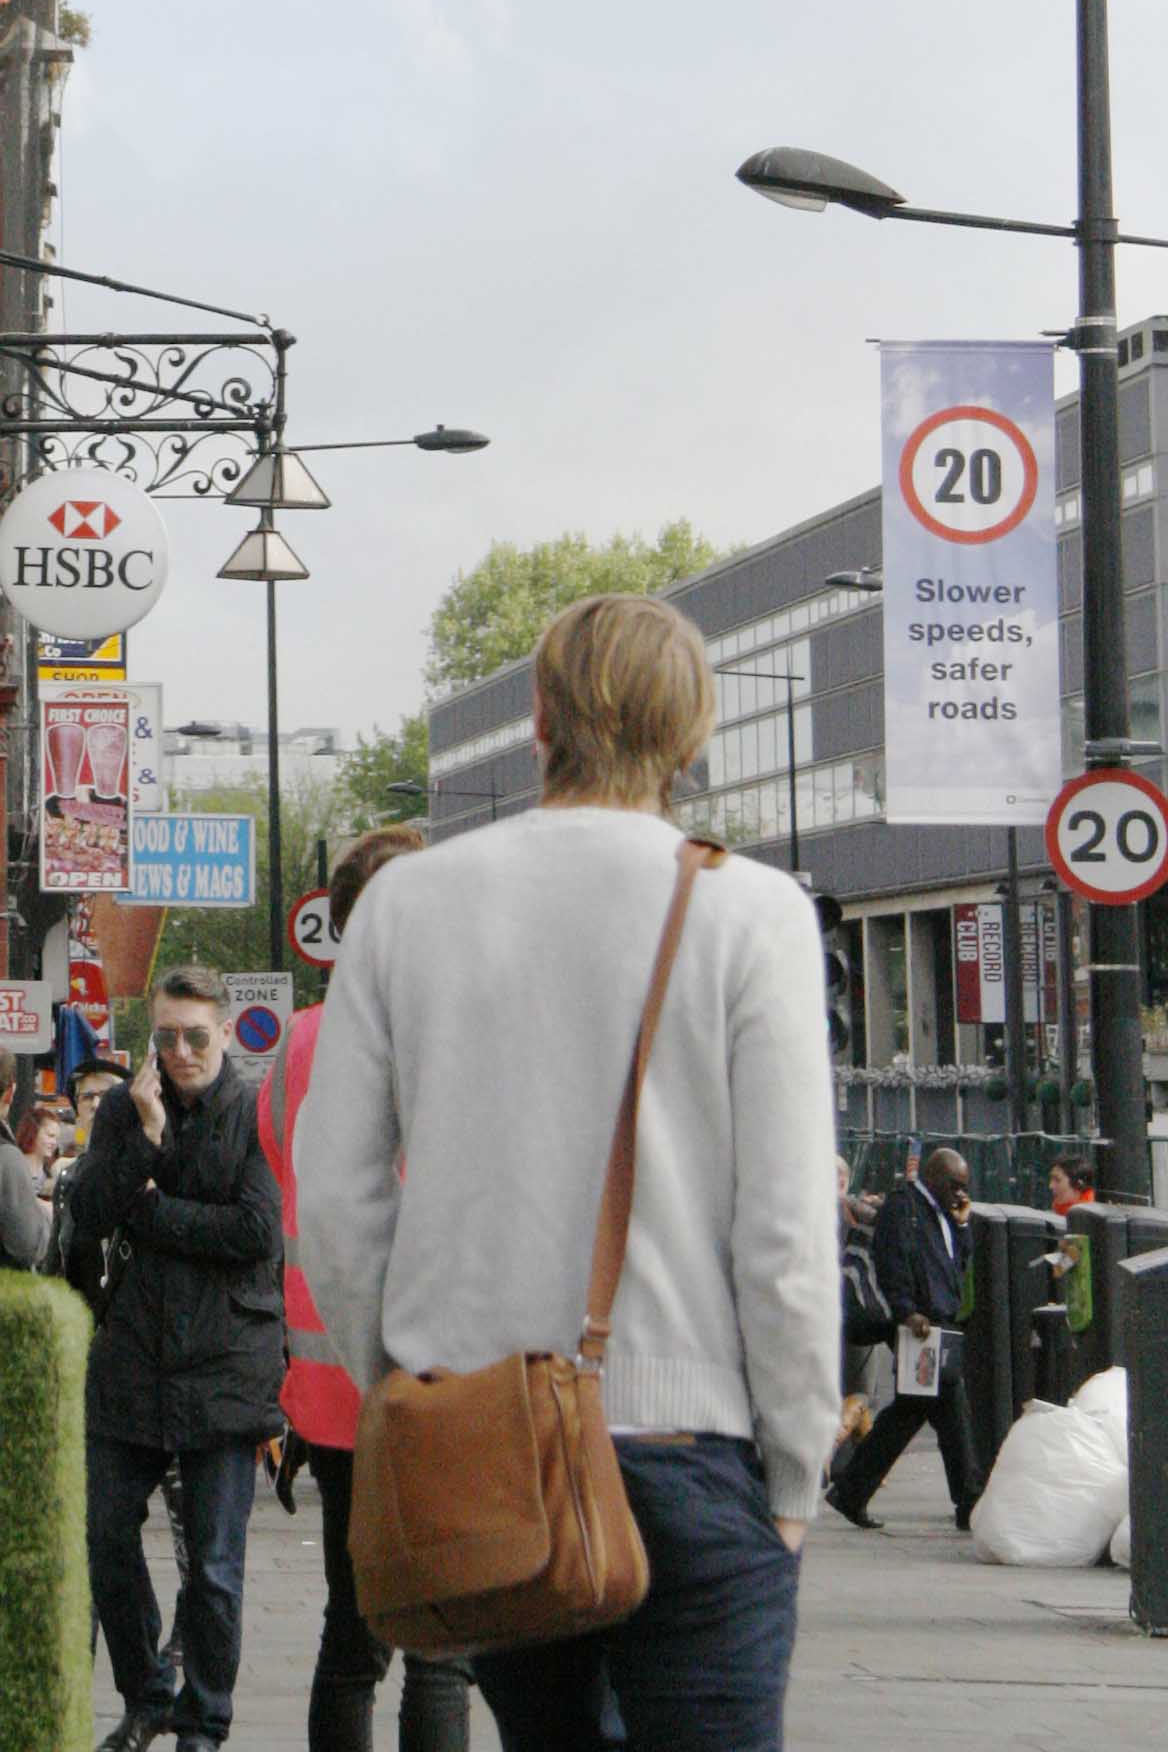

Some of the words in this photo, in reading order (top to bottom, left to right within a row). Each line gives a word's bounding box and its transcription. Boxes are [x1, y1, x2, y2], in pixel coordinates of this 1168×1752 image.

[934, 448, 1002, 504] 20
[13, 546, 153, 590] HSBC
[915, 578, 1026, 603] Slower
[908, 619, 1033, 647] speeds,
[931, 658, 1013, 681] safer
[48, 709, 81, 722] FIRST
[84, 709, 127, 723] CHOICE
[928, 697, 1018, 720] roads
[133, 820, 169, 853] OOD
[173, 820, 189, 853] &
[192, 820, 240, 854] WINE
[1067, 810, 1159, 863] 20
[48, 871, 122, 886] OPEN
[176, 864, 191, 897] &
[195, 864, 245, 898] MAGS
[957, 920, 978, 961] CLUB
[983, 921, 1002, 982] RECORD
[226, 975, 288, 986] Controlled
[235, 989, 278, 1001] ZONE
